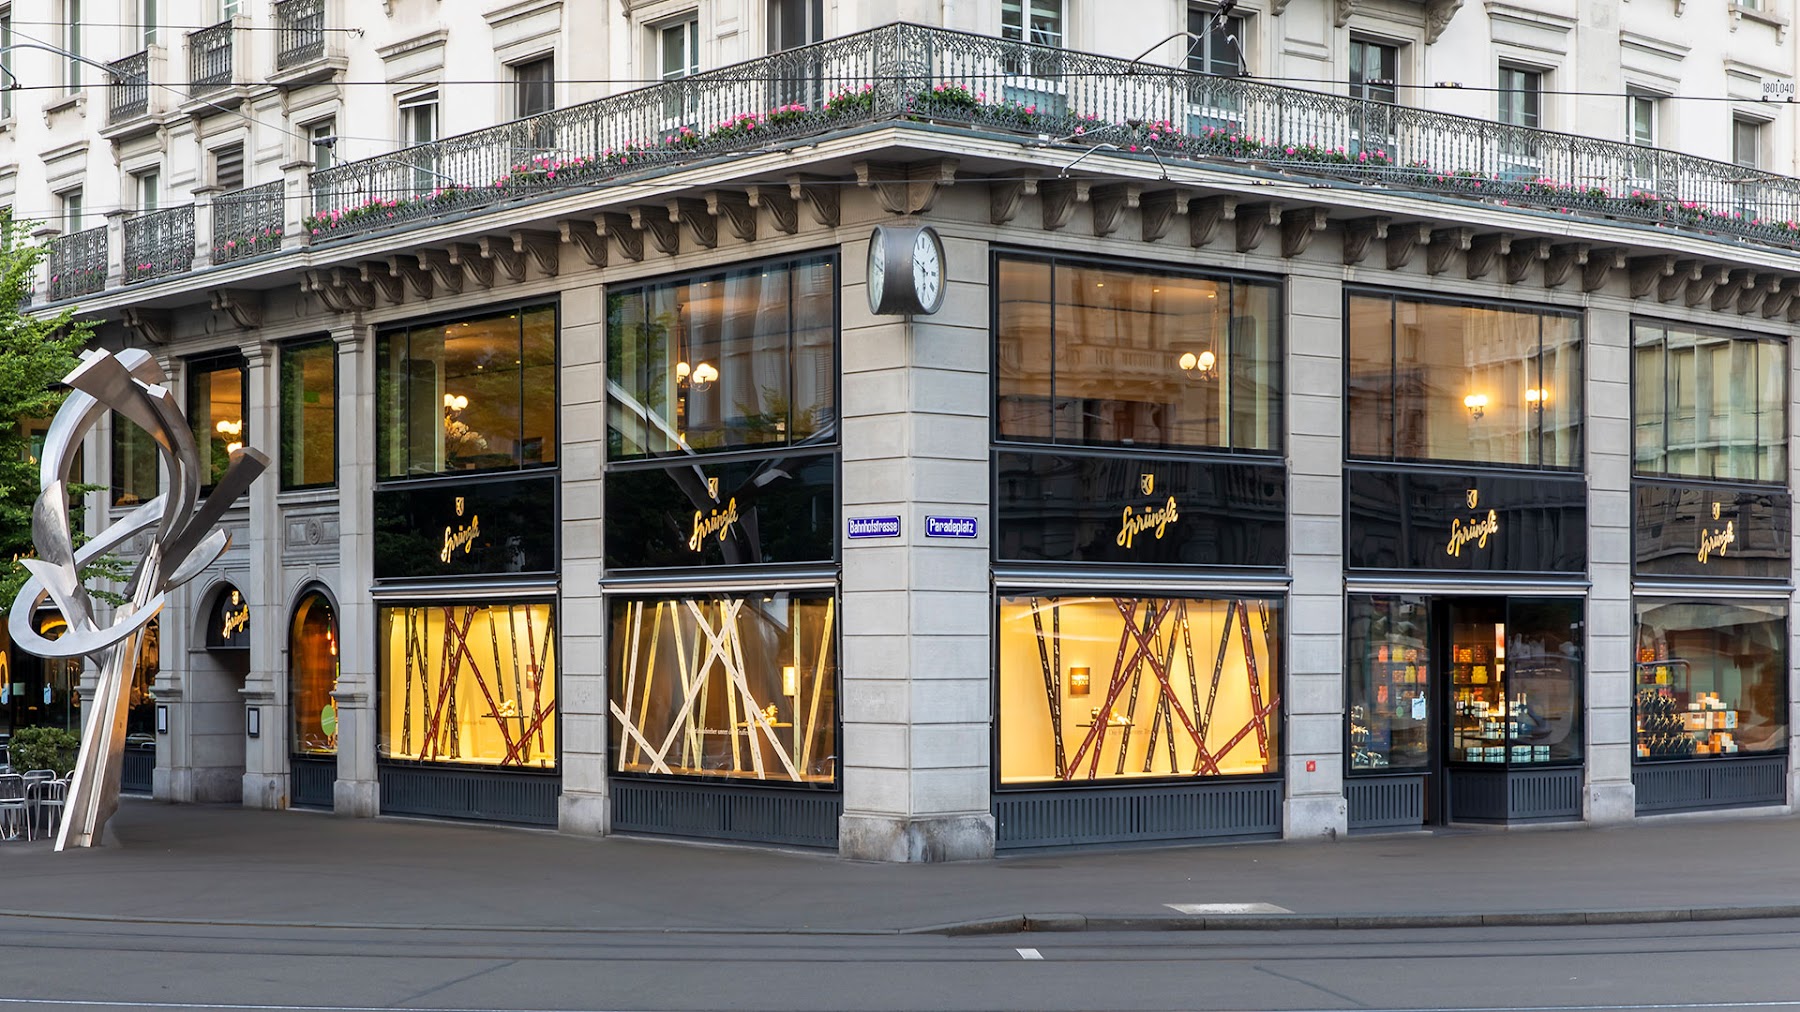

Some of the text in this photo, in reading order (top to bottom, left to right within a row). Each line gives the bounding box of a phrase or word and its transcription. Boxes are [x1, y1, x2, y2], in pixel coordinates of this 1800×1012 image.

[440, 514, 480, 564] Sprüngli
[689, 496, 739, 552] Sprüngli
[849, 518, 898, 534] Bahnhofstrasse
[929, 518, 974, 536] Paradeplatz
[1116, 495, 1179, 549] Sprüngli
[1446, 508, 1499, 557] Sprüngli
[1697, 520, 1735, 565] Sprüngli
